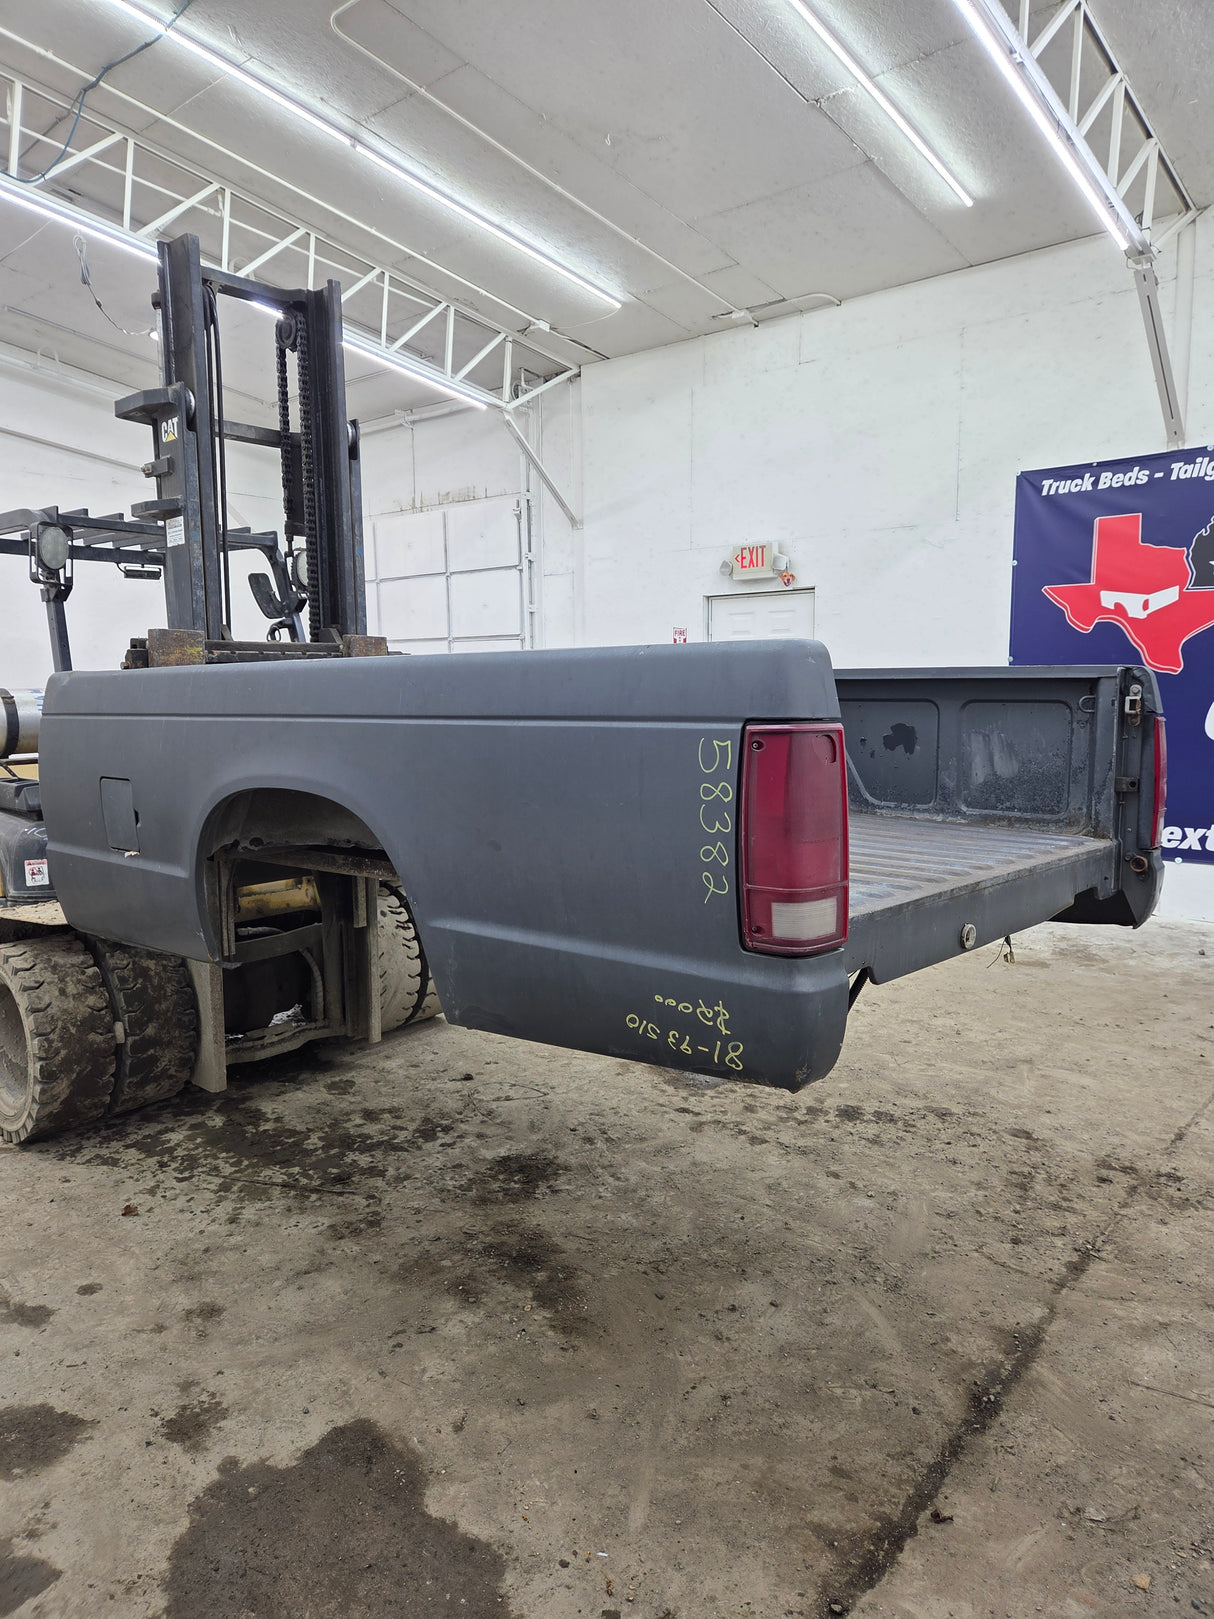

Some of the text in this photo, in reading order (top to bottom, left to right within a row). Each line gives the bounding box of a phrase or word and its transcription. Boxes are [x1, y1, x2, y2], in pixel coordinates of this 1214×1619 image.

[161, 416, 179, 442] CAT
[1041, 473, 1095, 496] Truck
[1097, 466, 1150, 489] Beds
[741, 545, 766, 569] EXIT
[674, 629, 686, 637] FIRE
[698, 737, 733, 904] 58382
[667, 1030, 744, 1071] 81-93
